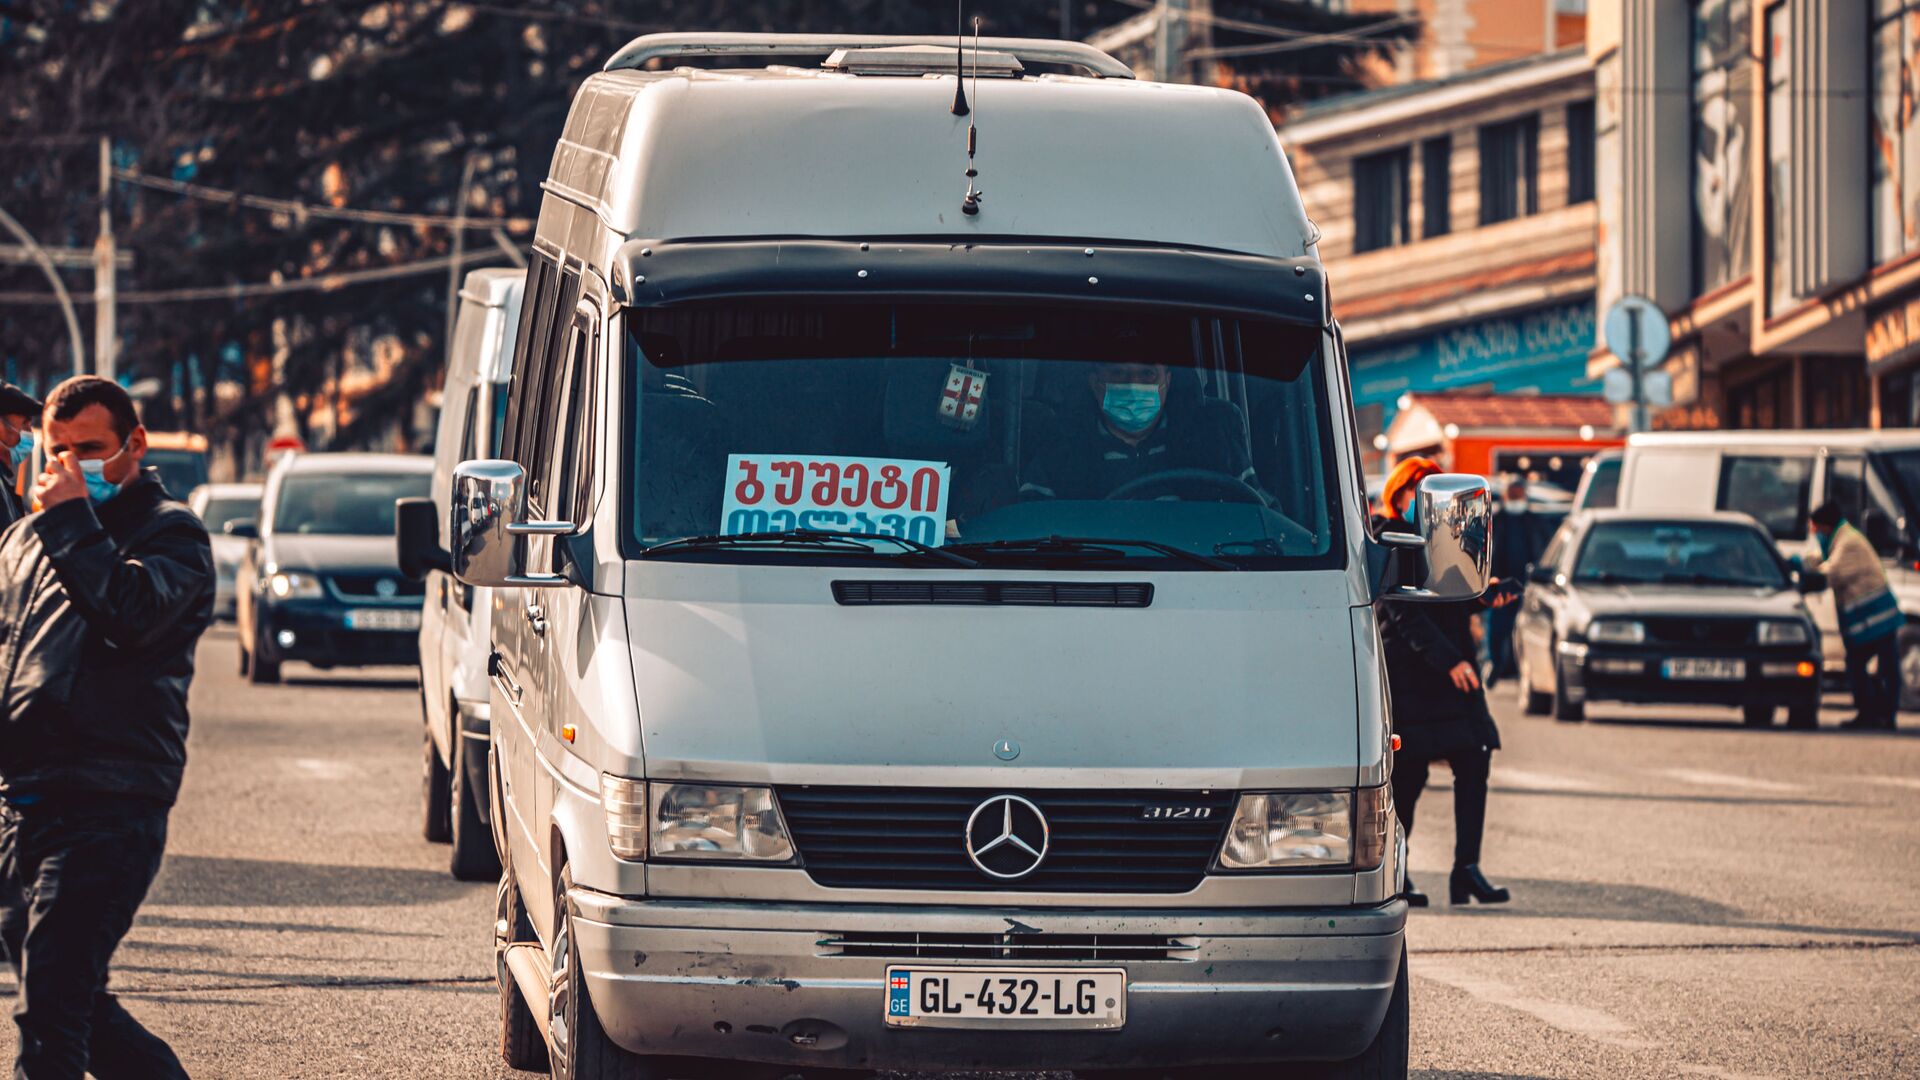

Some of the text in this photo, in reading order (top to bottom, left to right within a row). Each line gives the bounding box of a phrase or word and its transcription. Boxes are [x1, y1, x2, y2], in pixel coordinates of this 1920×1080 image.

[735, 460, 940, 512] ბუშეტი
[890, 999, 908, 1013] GE
[920, 977, 1096, 1015] GL-432-LG
